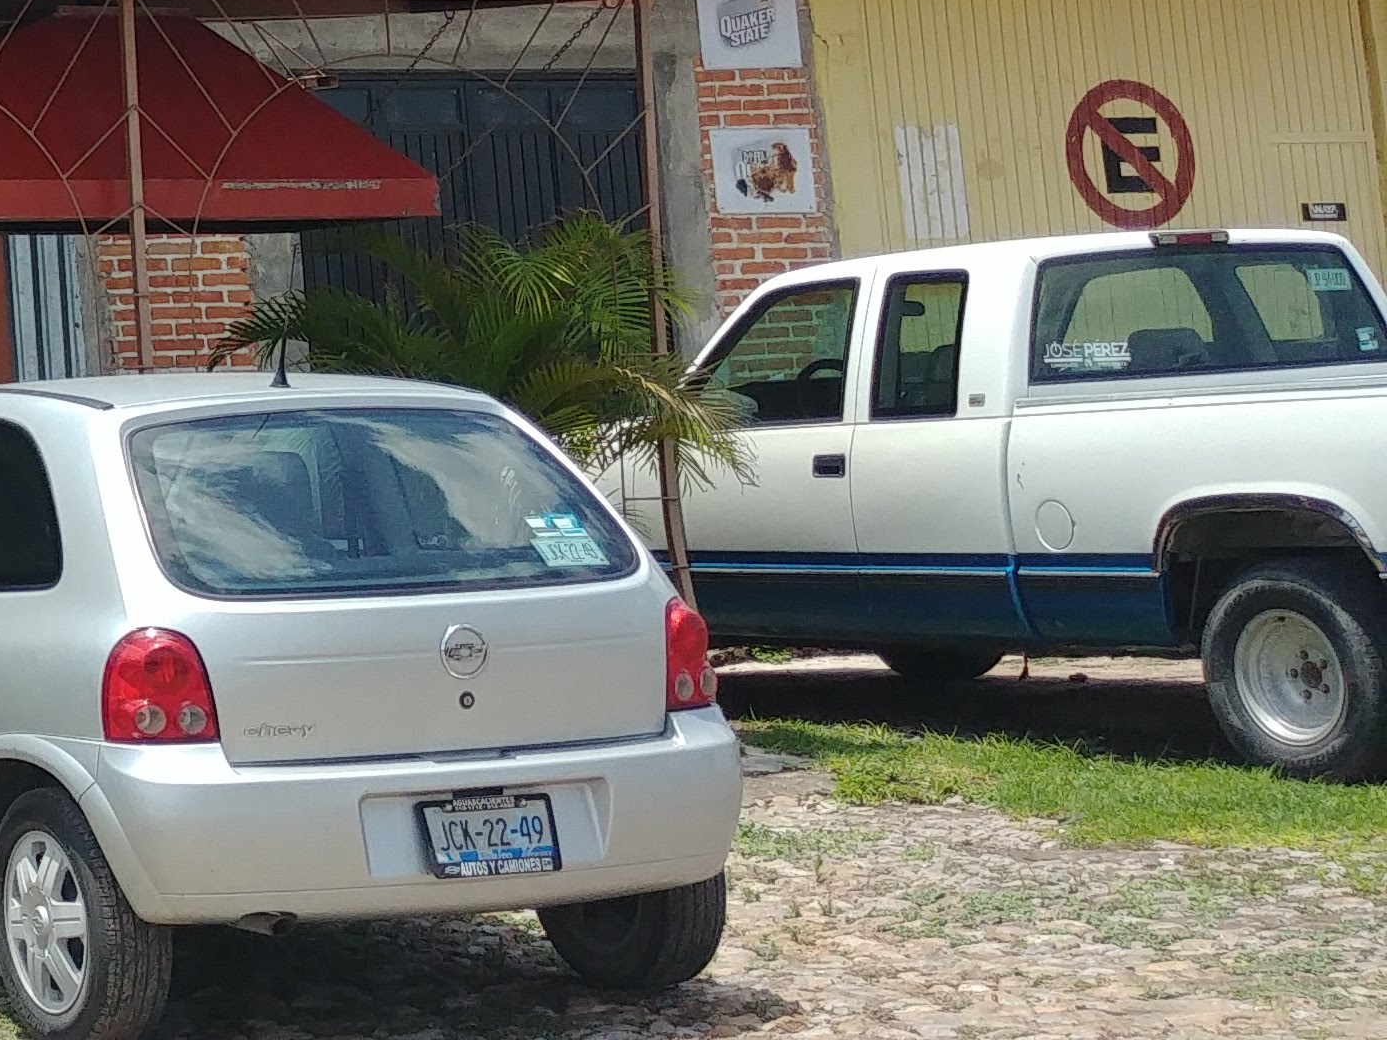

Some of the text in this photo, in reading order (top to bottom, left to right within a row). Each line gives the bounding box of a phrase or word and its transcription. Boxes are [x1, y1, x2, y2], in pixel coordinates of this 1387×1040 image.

[719, 8, 775, 39] QUAKER
[729, 22, 769, 48] STATE
[1043, 339, 1131, 359] JOSÉ PÉREZ
[440, 815, 545, 852] JCK-22-49
[460, 857, 543, 877] AUTOS Y CAMIONES
